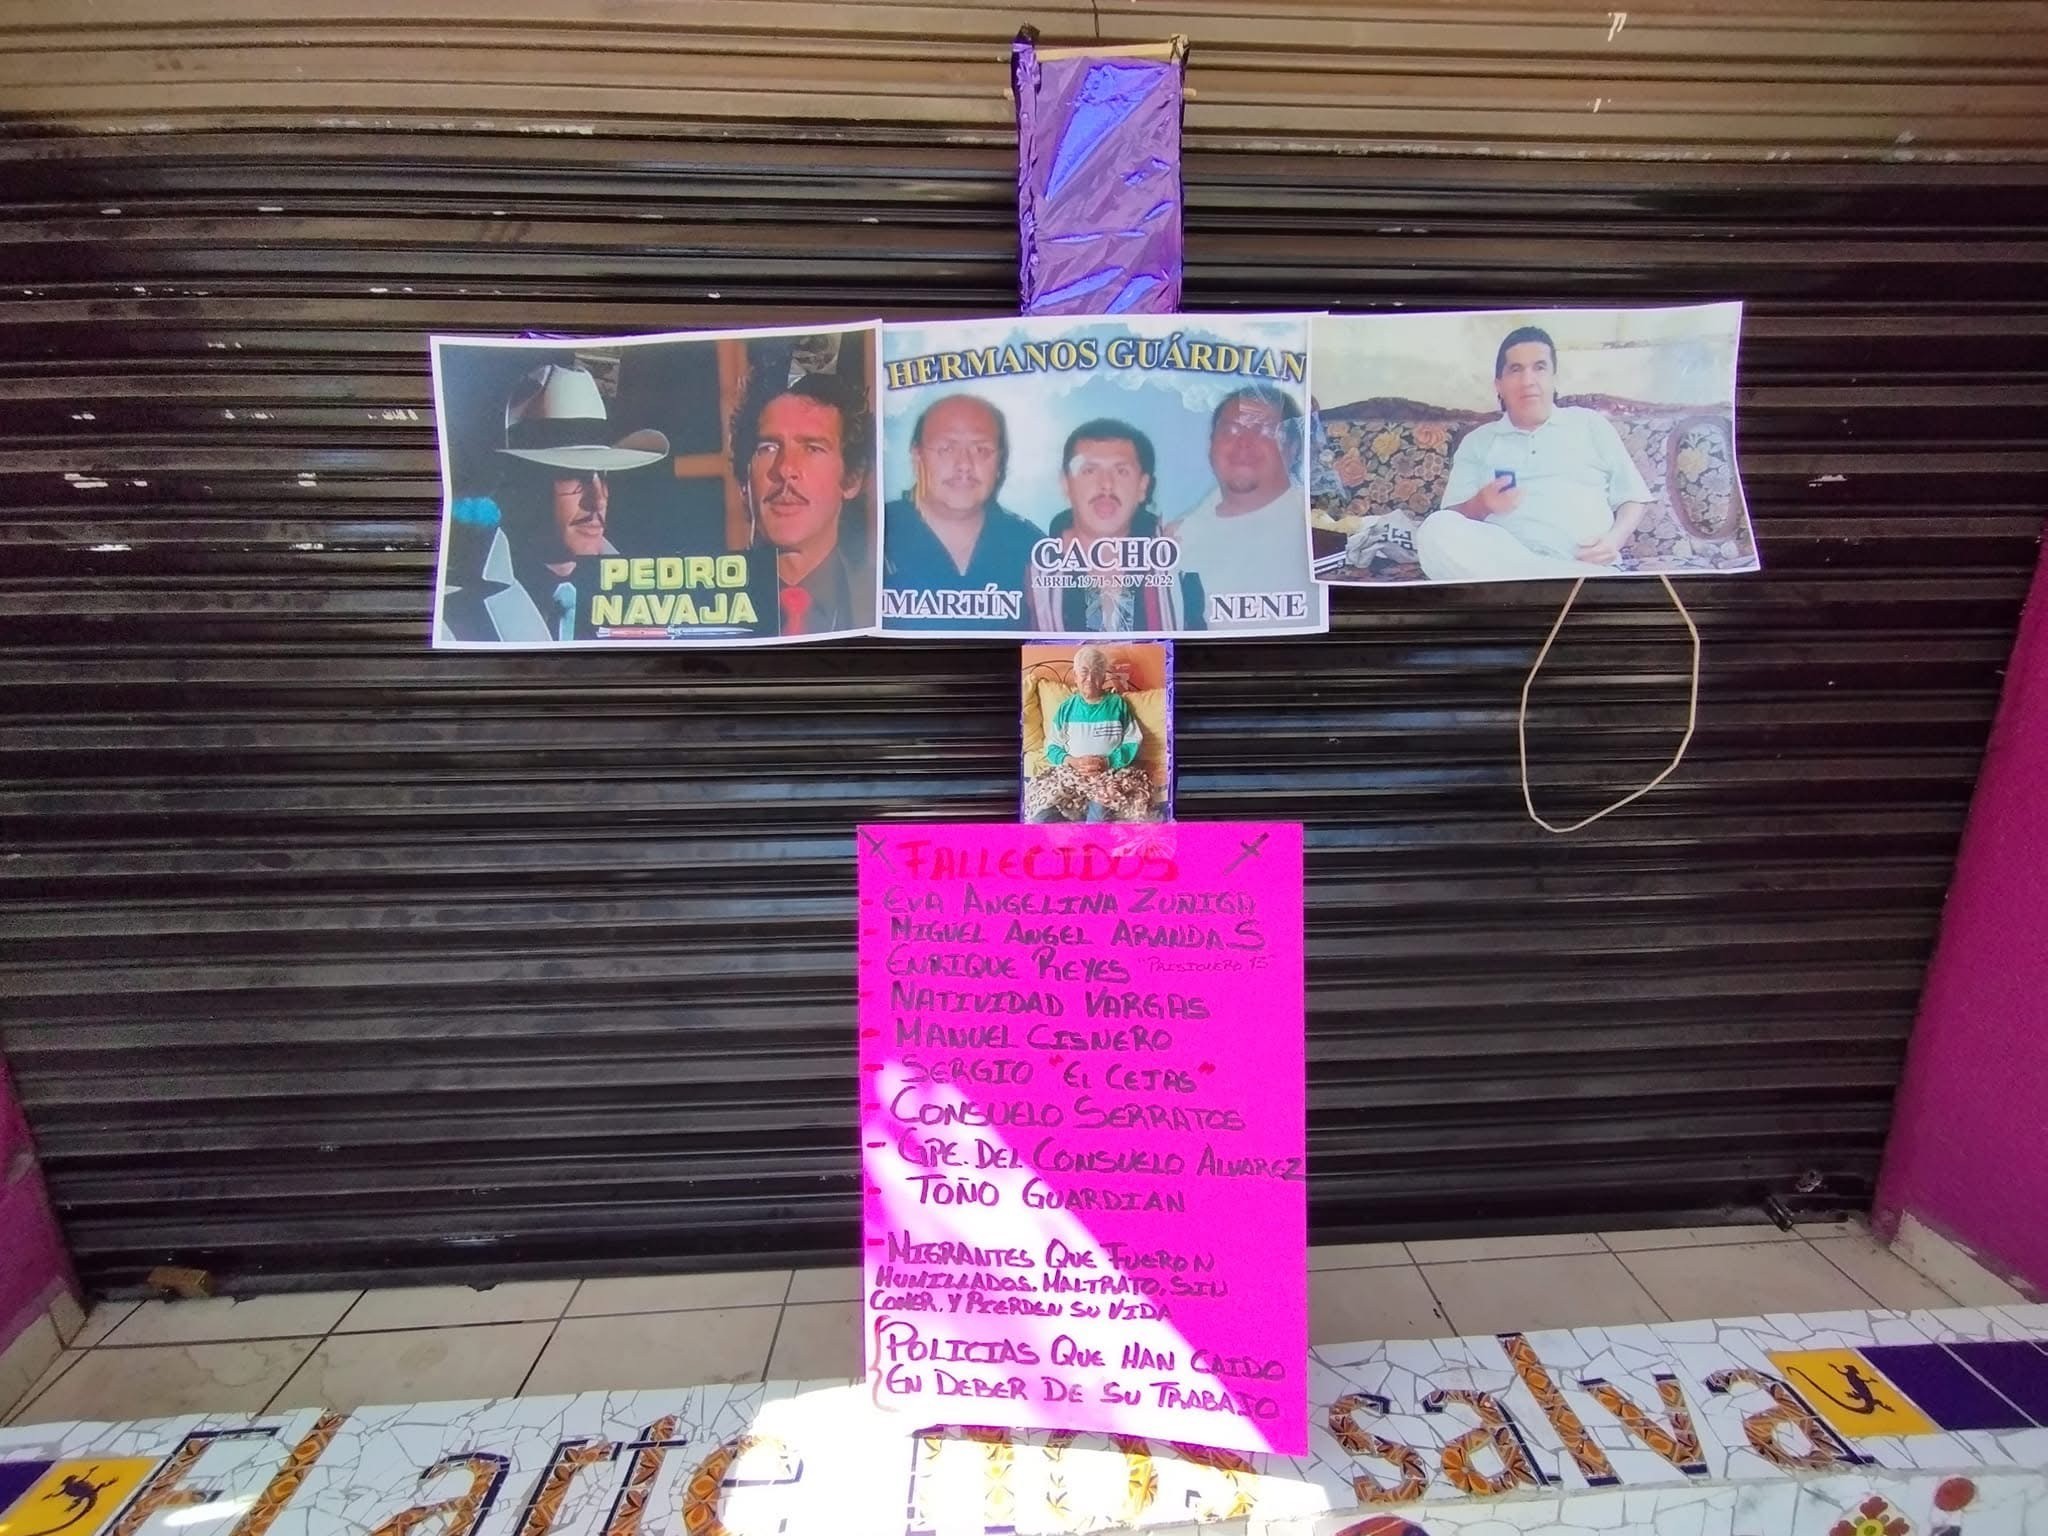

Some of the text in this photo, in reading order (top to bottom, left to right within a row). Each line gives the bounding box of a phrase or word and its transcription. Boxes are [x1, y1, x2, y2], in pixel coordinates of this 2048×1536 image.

[884, 332, 1308, 392] HERMANOS GUÁRDIAN
[1033, 538, 1179, 571] CACHO
[600, 555, 748, 591] PEDRO
[1032, 574, 1076, 588] ABRIL
[1112, 574, 1144, 588] NOV
[1145, 574, 1174, 587] 2022
[591, 594, 759, 626] NAVAJA
[883, 583, 1022, 619] MARTÍN
[1210, 591, 1308, 622] NENE
[896, 840, 1178, 882] FALLECIDOS
[882, 884, 943, 914] EVA
[963, 882, 1119, 915] ANGELINA
[890, 915, 988, 944] MIGUEL
[1003, 918, 1094, 946] ANGEL
[886, 944, 1019, 979] ENRIQUE
[1031, 946, 1131, 984] REYES
[890, 980, 1211, 1020] NATIVIDAD VARGAS
[896, 1017, 1173, 1051] MANUEL CISNERO
[900, 1053, 1034, 1085] SERGIO
[890, 1086, 1065, 1127] CONSUELO
[974, 1138, 1023, 1169] DEL
[1033, 1136, 1185, 1175] CONSUELO
[1196, 1143, 1305, 1182] ALVAREZ
[905, 1174, 1186, 1213] TOÑO GUARDIAN
[1045, 1238, 1098, 1269] QUE
[1170, 1275, 1229, 1298] SIN
[948, 1293, 962, 1313] Y
[965, 1290, 1063, 1317] PIERDEN
[1070, 1301, 1102, 1318] SU
[1108, 1298, 1173, 1322] VIDA
[879, 1321, 1286, 1381] POLICIAS QUE HAN CAIDO
[886, 1363, 1280, 1420] EN DEBER DE SU TRABAJO
[1328, 1333, 1876, 1506] salva
